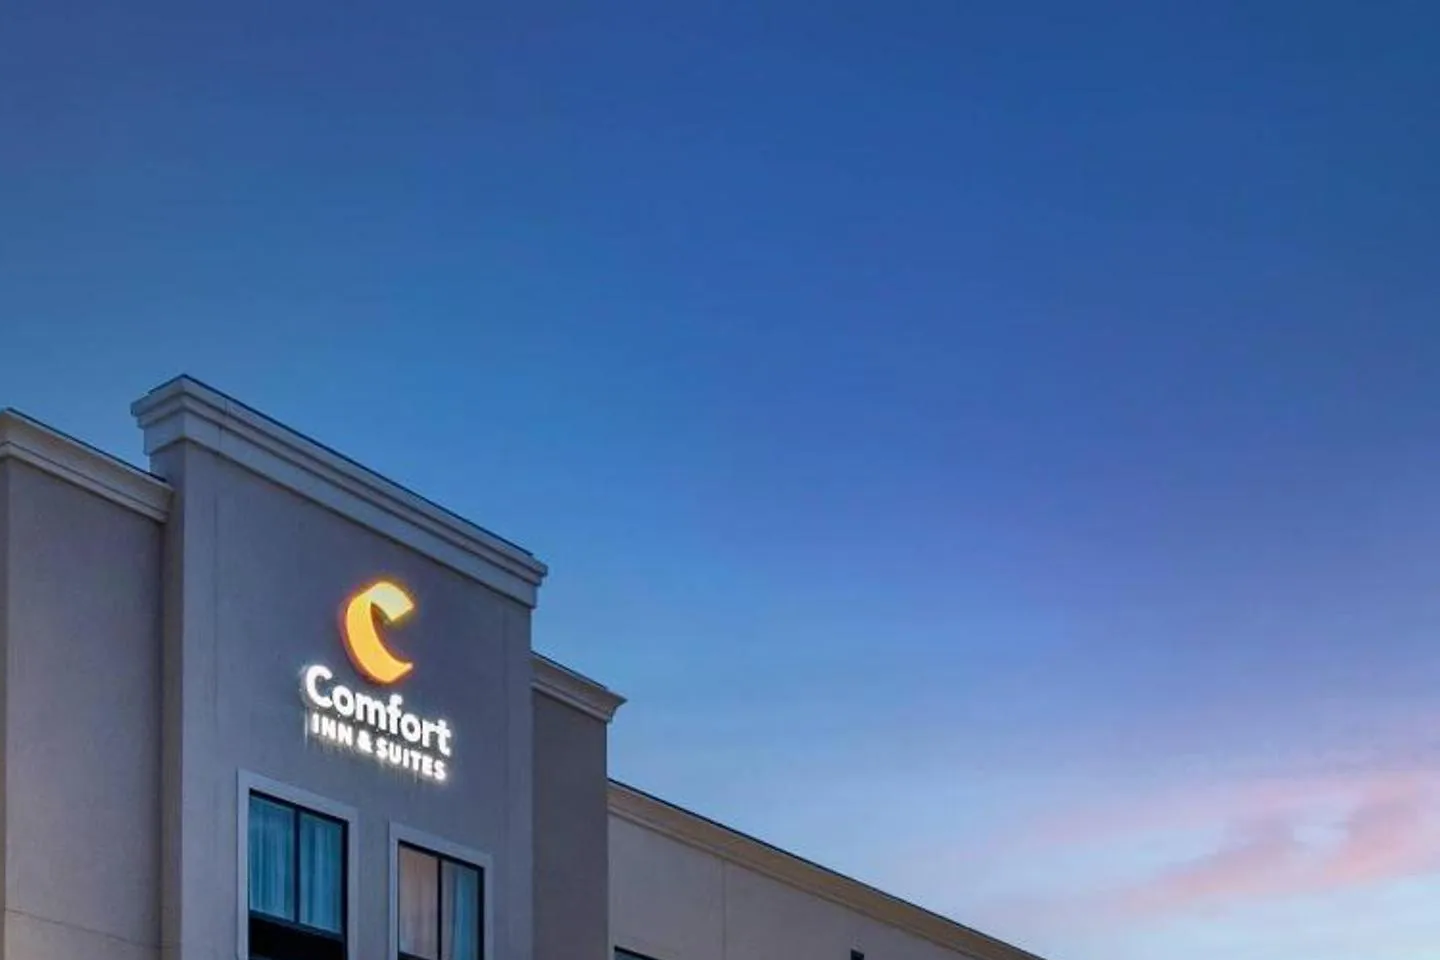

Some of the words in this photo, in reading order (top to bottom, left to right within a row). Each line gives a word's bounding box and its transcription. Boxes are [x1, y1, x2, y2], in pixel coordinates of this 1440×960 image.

[305, 664, 452, 757] Comfort
[311, 713, 353, 747] INN
[357, 730, 374, 754] &
[376, 737, 448, 782] SUITES
